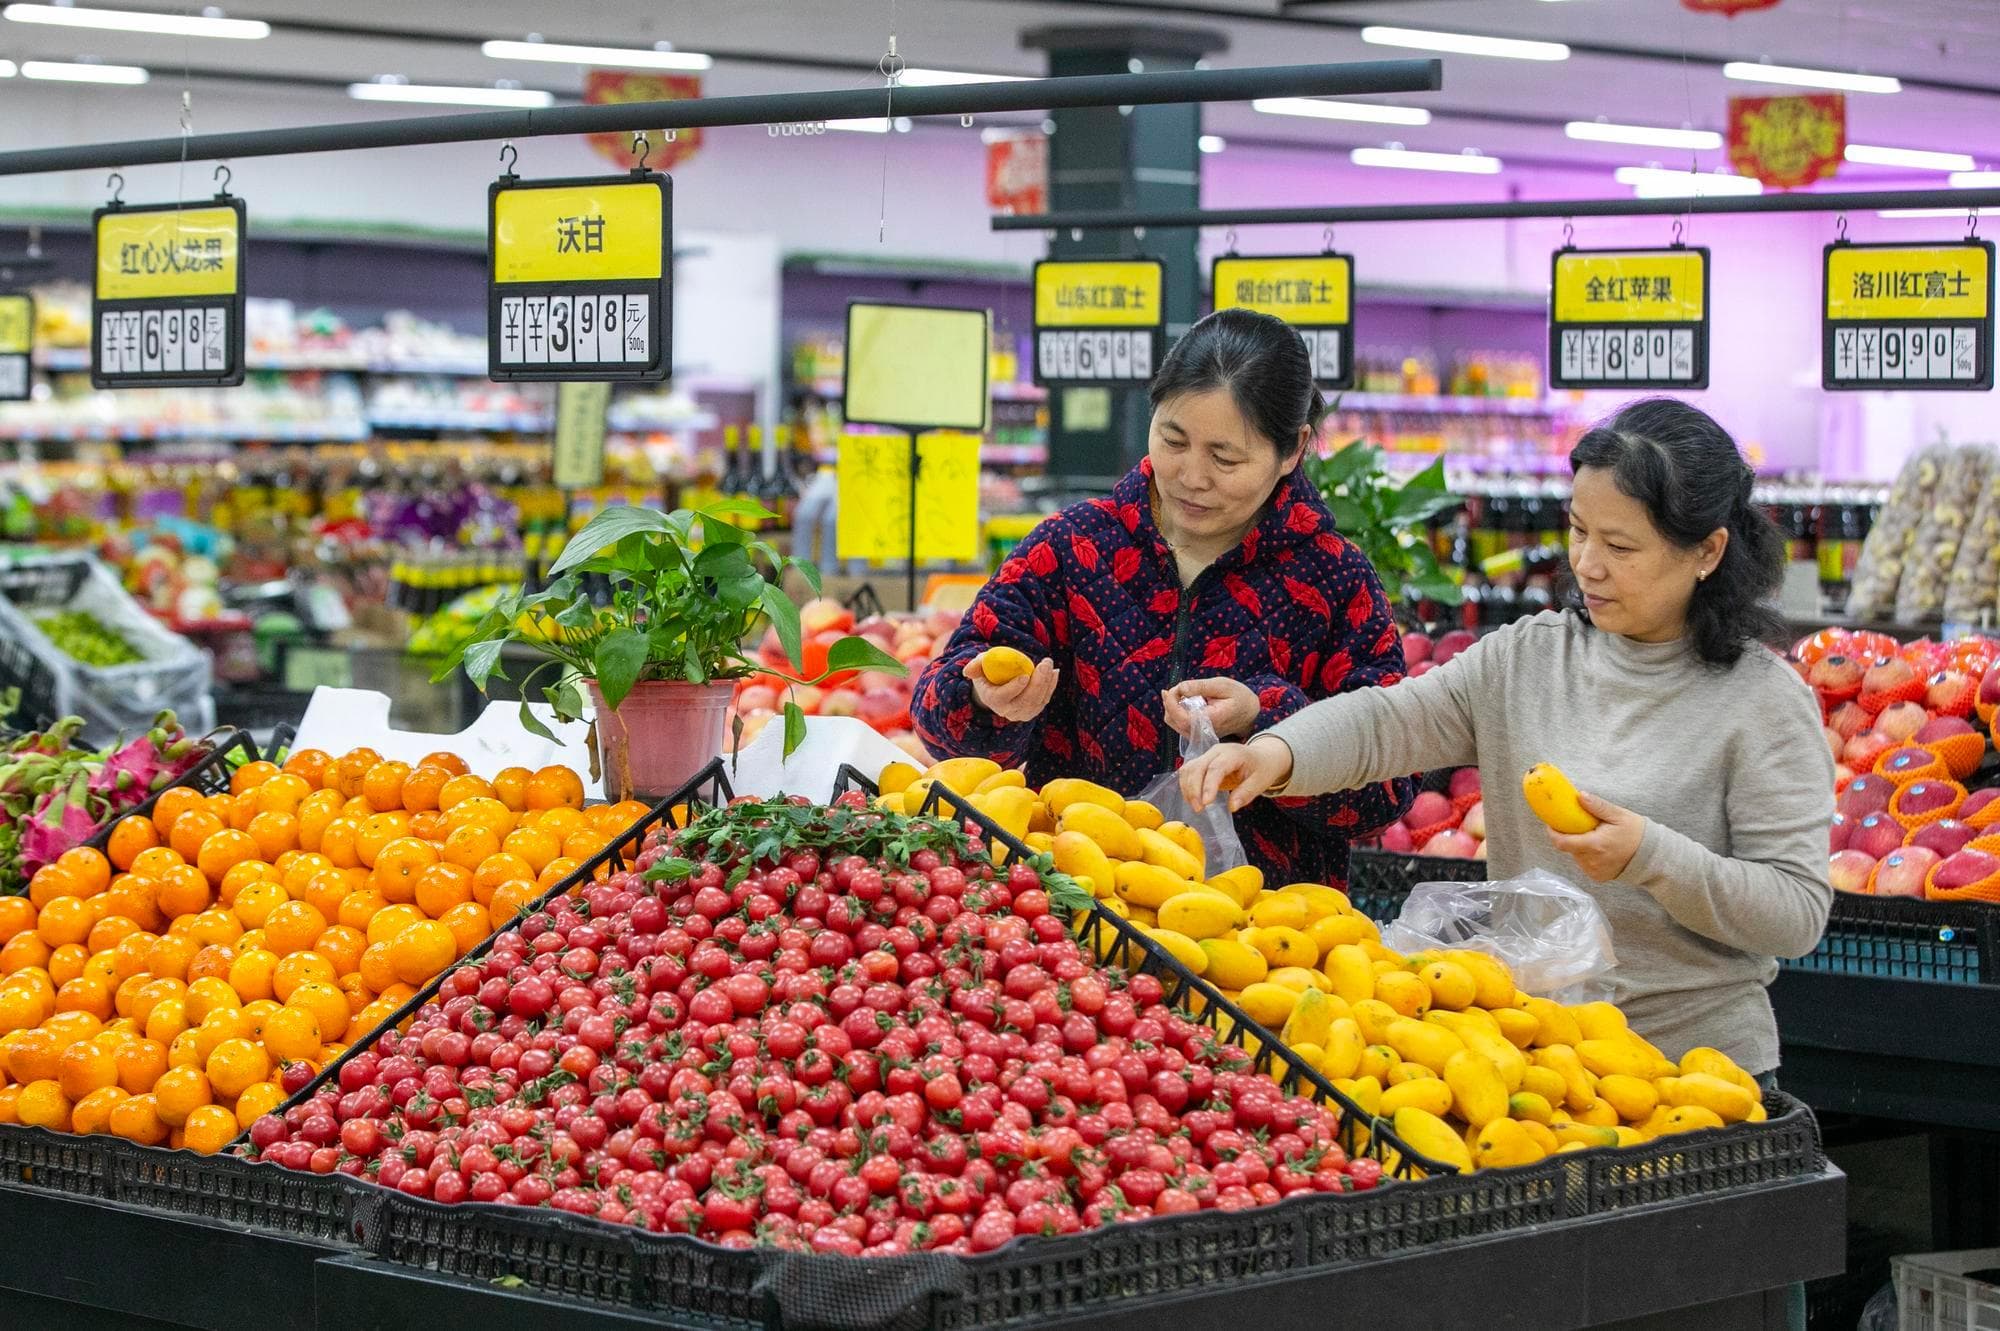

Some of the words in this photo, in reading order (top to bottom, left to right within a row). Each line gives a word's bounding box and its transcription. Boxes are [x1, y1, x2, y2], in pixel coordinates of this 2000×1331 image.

[557, 215, 605, 253] 沃甘
[121, 239, 223, 274] 红心火龙果
[1056, 283, 1145, 310] 山东红富士
[1236, 277, 1333, 304] 烟台红富士
[1585, 276, 1672, 303] 全红苹果
[1853, 270, 1971, 299] 洛川红富士
